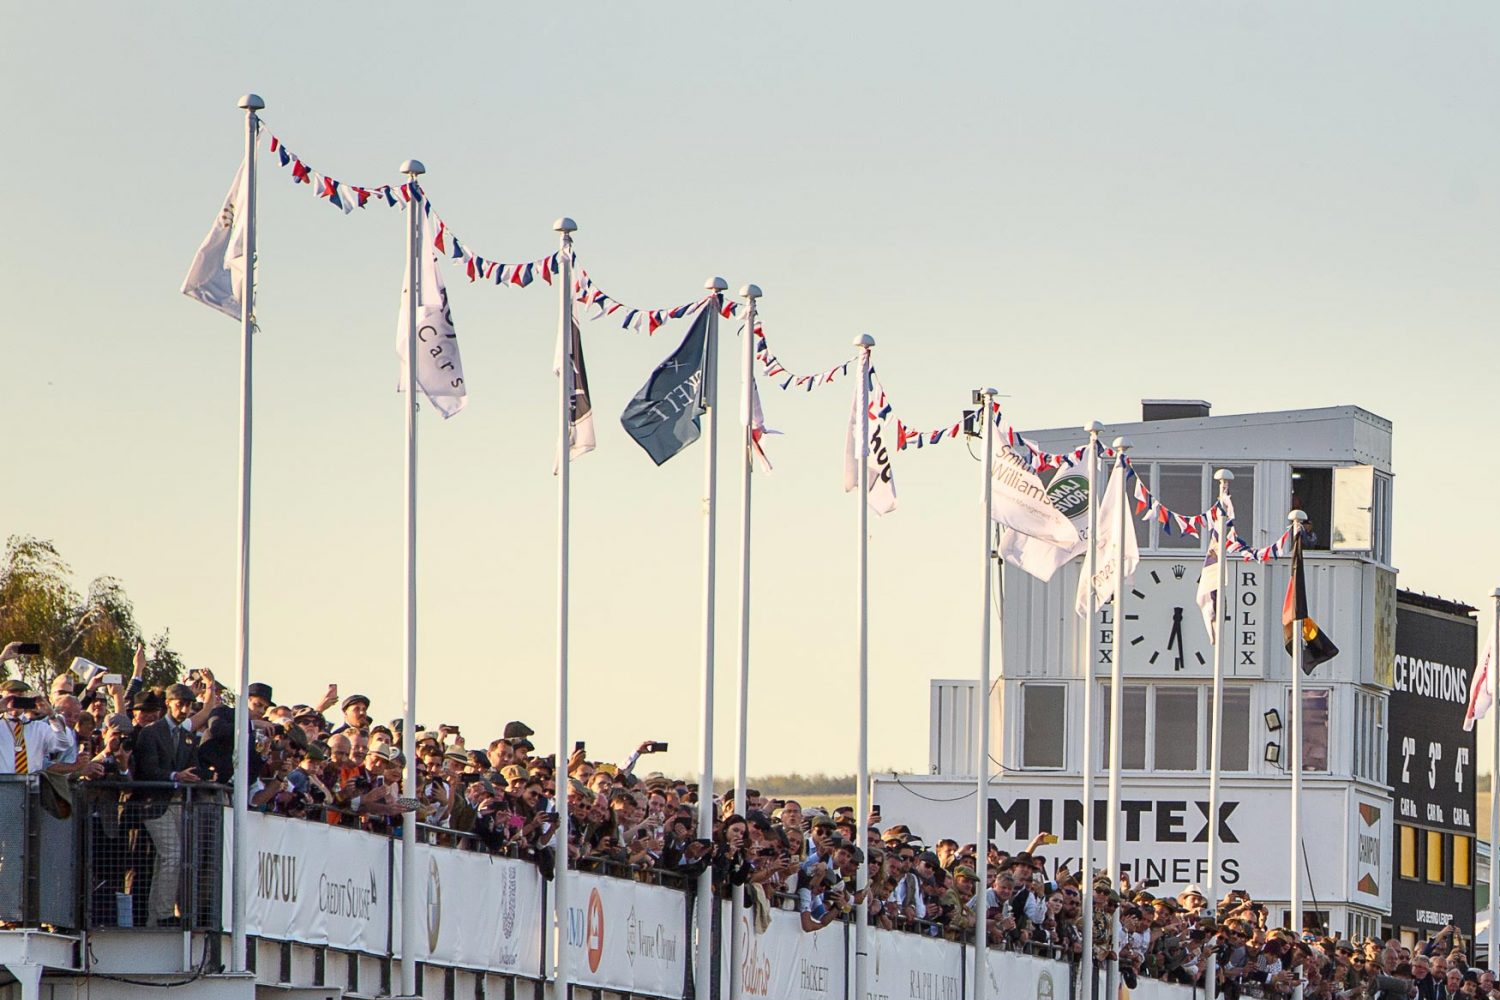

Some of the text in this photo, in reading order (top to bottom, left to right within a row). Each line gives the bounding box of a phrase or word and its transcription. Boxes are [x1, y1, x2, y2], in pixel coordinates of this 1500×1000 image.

[418, 325, 464, 389] Cars
[1241, 571, 1258, 665] ROLEX
[1409, 656, 1467, 705] POSITIONS
[987, 797, 1240, 843] MINTEX
[257, 850, 298, 903] MOTUL
